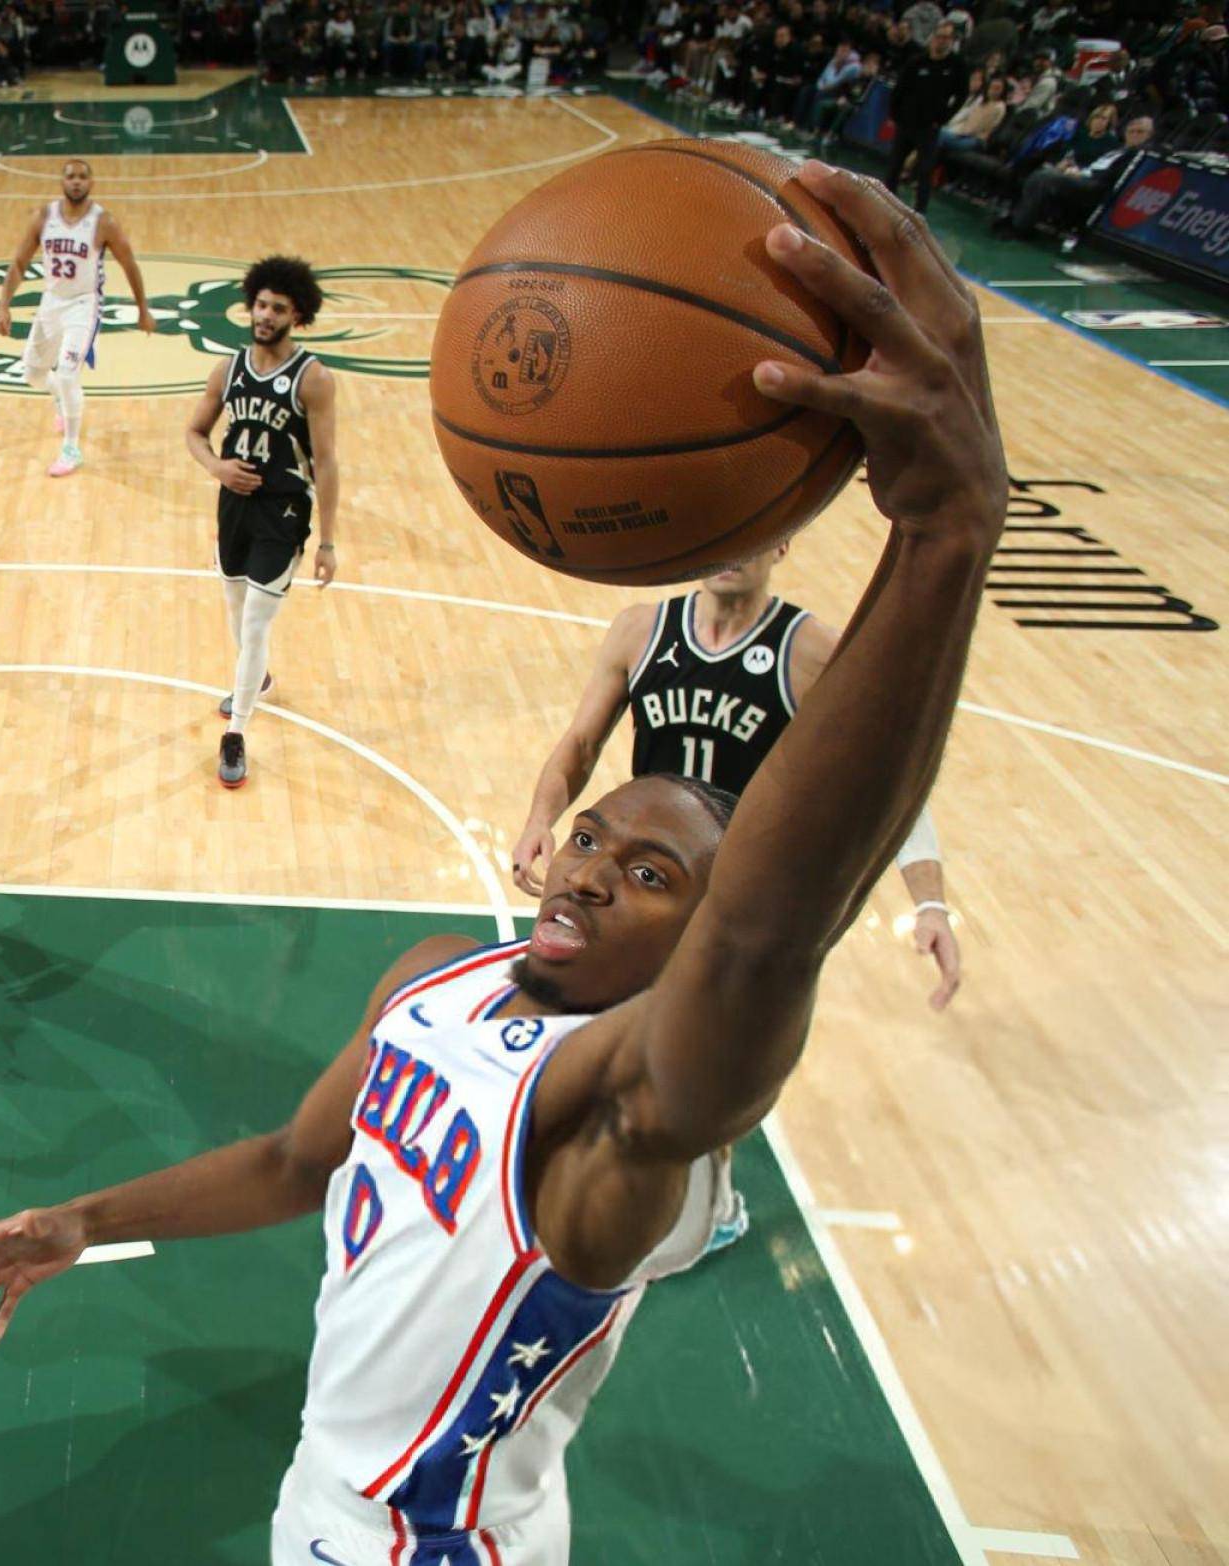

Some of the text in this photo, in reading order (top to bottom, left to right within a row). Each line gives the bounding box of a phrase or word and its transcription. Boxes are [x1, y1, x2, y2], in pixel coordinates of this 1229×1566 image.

[1125, 185, 1229, 257] we Energ
[51, 257, 77, 279] 23
[234, 428, 271, 464] 44
[641, 687, 768, 743] BUCKS
[682, 735, 715, 784] 11
[357, 1036, 482, 1237] HILA
[342, 1162, 385, 1277] 0
